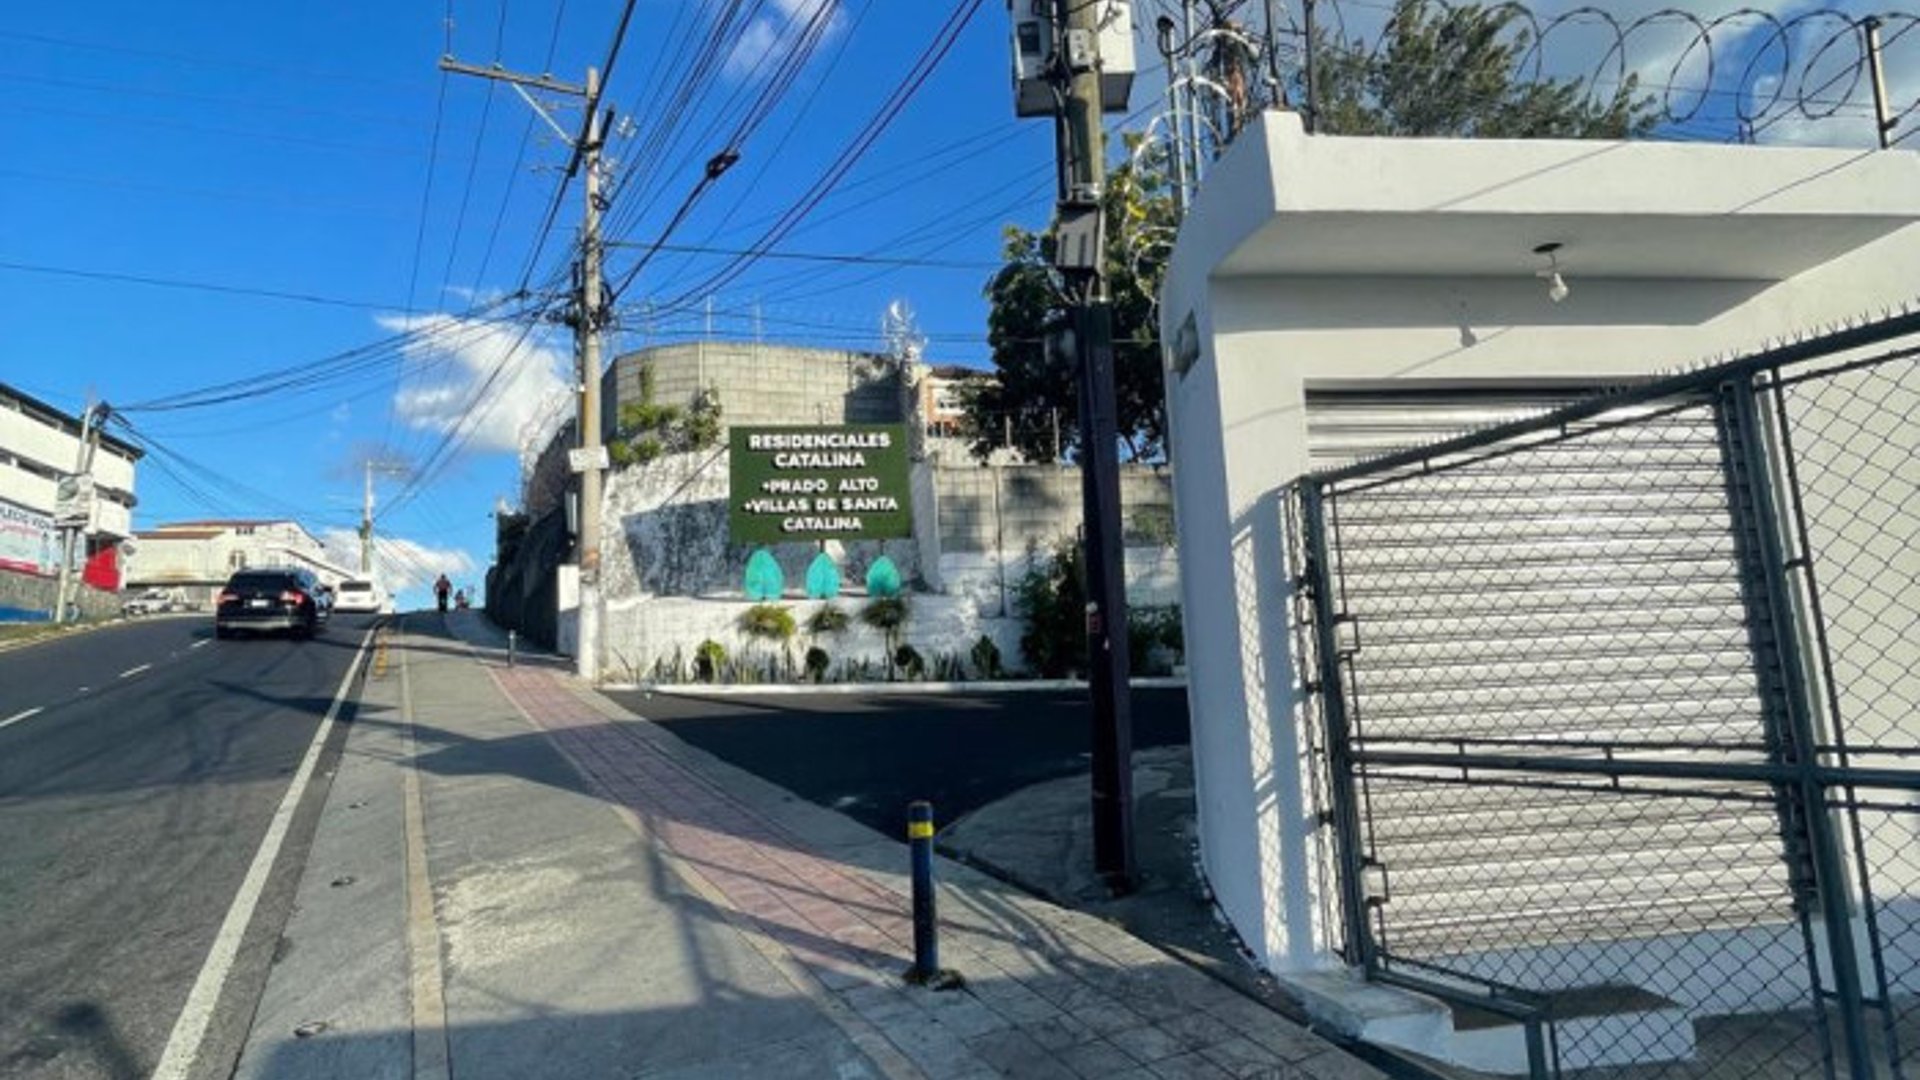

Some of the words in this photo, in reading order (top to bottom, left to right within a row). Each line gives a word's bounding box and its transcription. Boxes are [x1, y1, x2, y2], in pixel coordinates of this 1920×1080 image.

[749, 432, 891, 449] RESIDENCIALES
[775, 452, 866, 467] CATALINA
[839, 477, 879, 491] ALTO
[816, 499, 837, 511] DE
[842, 497, 899, 511] SANTA
[783, 517, 863, 531] CATALINA
